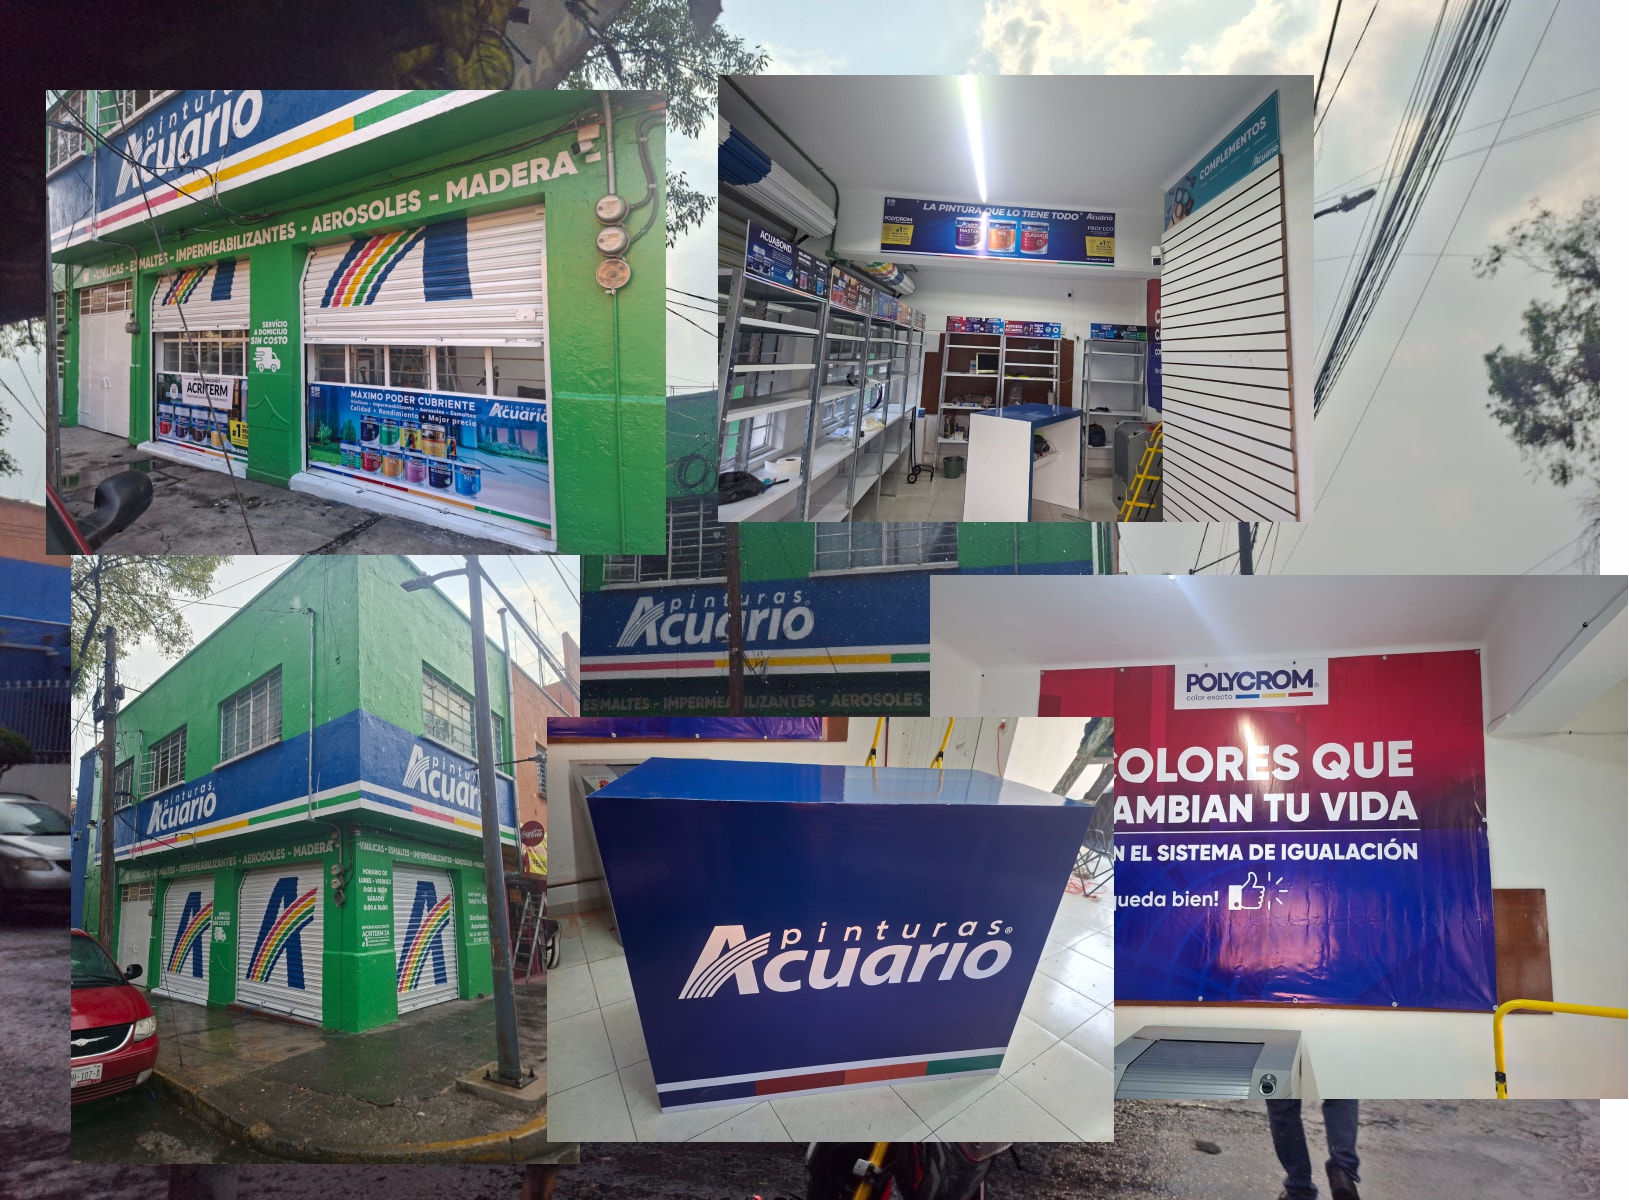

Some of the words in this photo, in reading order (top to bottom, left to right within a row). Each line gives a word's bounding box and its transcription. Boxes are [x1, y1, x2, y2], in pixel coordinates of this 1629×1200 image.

[115, 89, 263, 198] Acuario
[1199, 116, 1267, 180] COMPLEMENTOS
[175, 221, 296, 263] IMPERMEABILIZANTES
[311, 189, 421, 234] AEROSOLES
[446, 150, 578, 203] MADERA
[923, 203, 936, 211] LA
[939, 203, 982, 214] PINTURA
[984, 207, 1005, 216] QUE
[1022, 210, 1050, 219] TIENE
[251, 337, 262, 345] SIN
[263, 336, 288, 345] COSTO
[186, 382, 228, 397] ACRITERM
[350, 389, 383, 401] MÁXIMO
[385, 394, 415, 405] PODER
[418, 397, 476, 412] CUBRIENTE
[378, 408, 420, 419] Rendimiento
[428, 415, 450, 424] Mejor
[452, 419, 477, 427] precio
[488, 402, 548, 423] Acuario
[830, 692, 923, 708] AEROSOLES
[1186, 693, 1206, 701] color
[1114, 744, 1300, 783] OLORES
[1312, 740, 1414, 781] QUE
[147, 792, 217, 835] Acuario
[1263, 793, 1310, 822] TU
[1320, 790, 1418, 821] VIDA
[242, 847, 286, 865] AEROSOLES
[293, 839, 333, 858] MADERA
[1130, 845, 1152, 861] EL
[1157, 844, 1243, 861] SISTEMA
[1249, 843, 1276, 860] DE
[1281, 837, 1418, 861] IGUALACIÓN
[362, 868, 381, 876] HORARIO
[1172, 890, 1219, 908] bien!
[678, 924, 1012, 1000] Acuario
